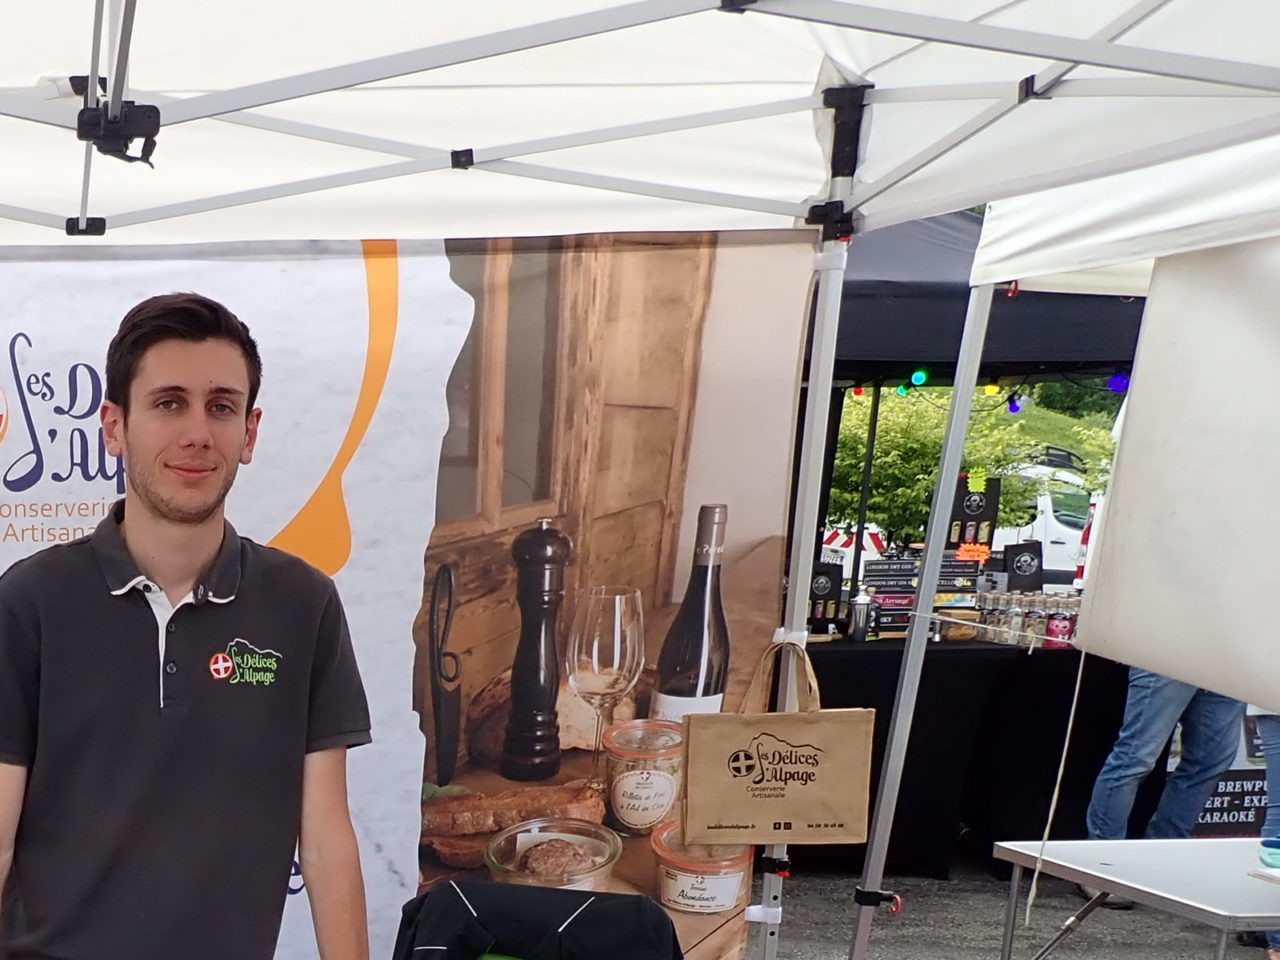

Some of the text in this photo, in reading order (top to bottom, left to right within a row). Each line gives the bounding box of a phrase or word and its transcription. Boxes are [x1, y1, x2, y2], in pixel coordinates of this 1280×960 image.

[2, 523, 95, 542] Artisan
[241, 653, 277, 671] Délices
[768, 749, 819, 768] Délices
